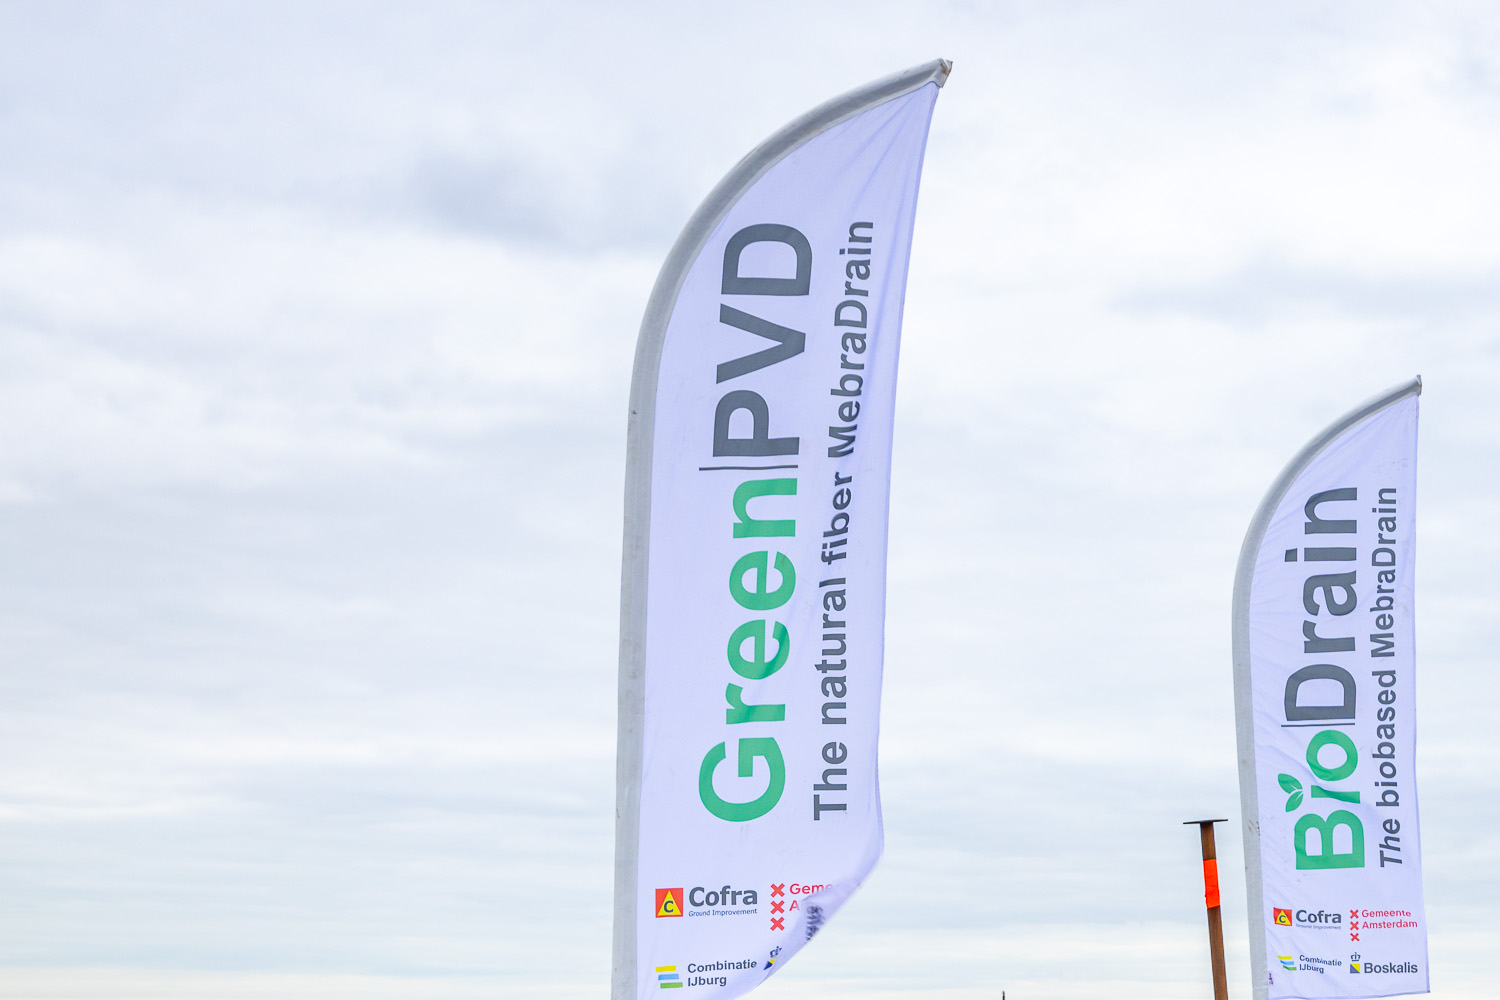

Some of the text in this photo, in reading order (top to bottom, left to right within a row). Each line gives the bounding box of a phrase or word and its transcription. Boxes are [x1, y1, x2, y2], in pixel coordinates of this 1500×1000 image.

[813, 221, 874, 821] The natural fiber MebraDrain
[1369, 487, 1403, 868] The biobased MebraDrain
[688, 885, 758, 907] Cofra
[688, 908, 758, 918] Ground Improvement
[1295, 909, 1342, 924] Cofra
[1361, 909, 1412, 918] Gemeente
[1361, 919, 1418, 930] Amsterdam
[687, 959, 758, 974] Combinatie
[1299, 954, 1342, 967] Combinatie
[1299, 963, 1325, 975] IJburg
[1363, 962, 1419, 974] Boskalis
[687, 975, 727, 988] IJburg
